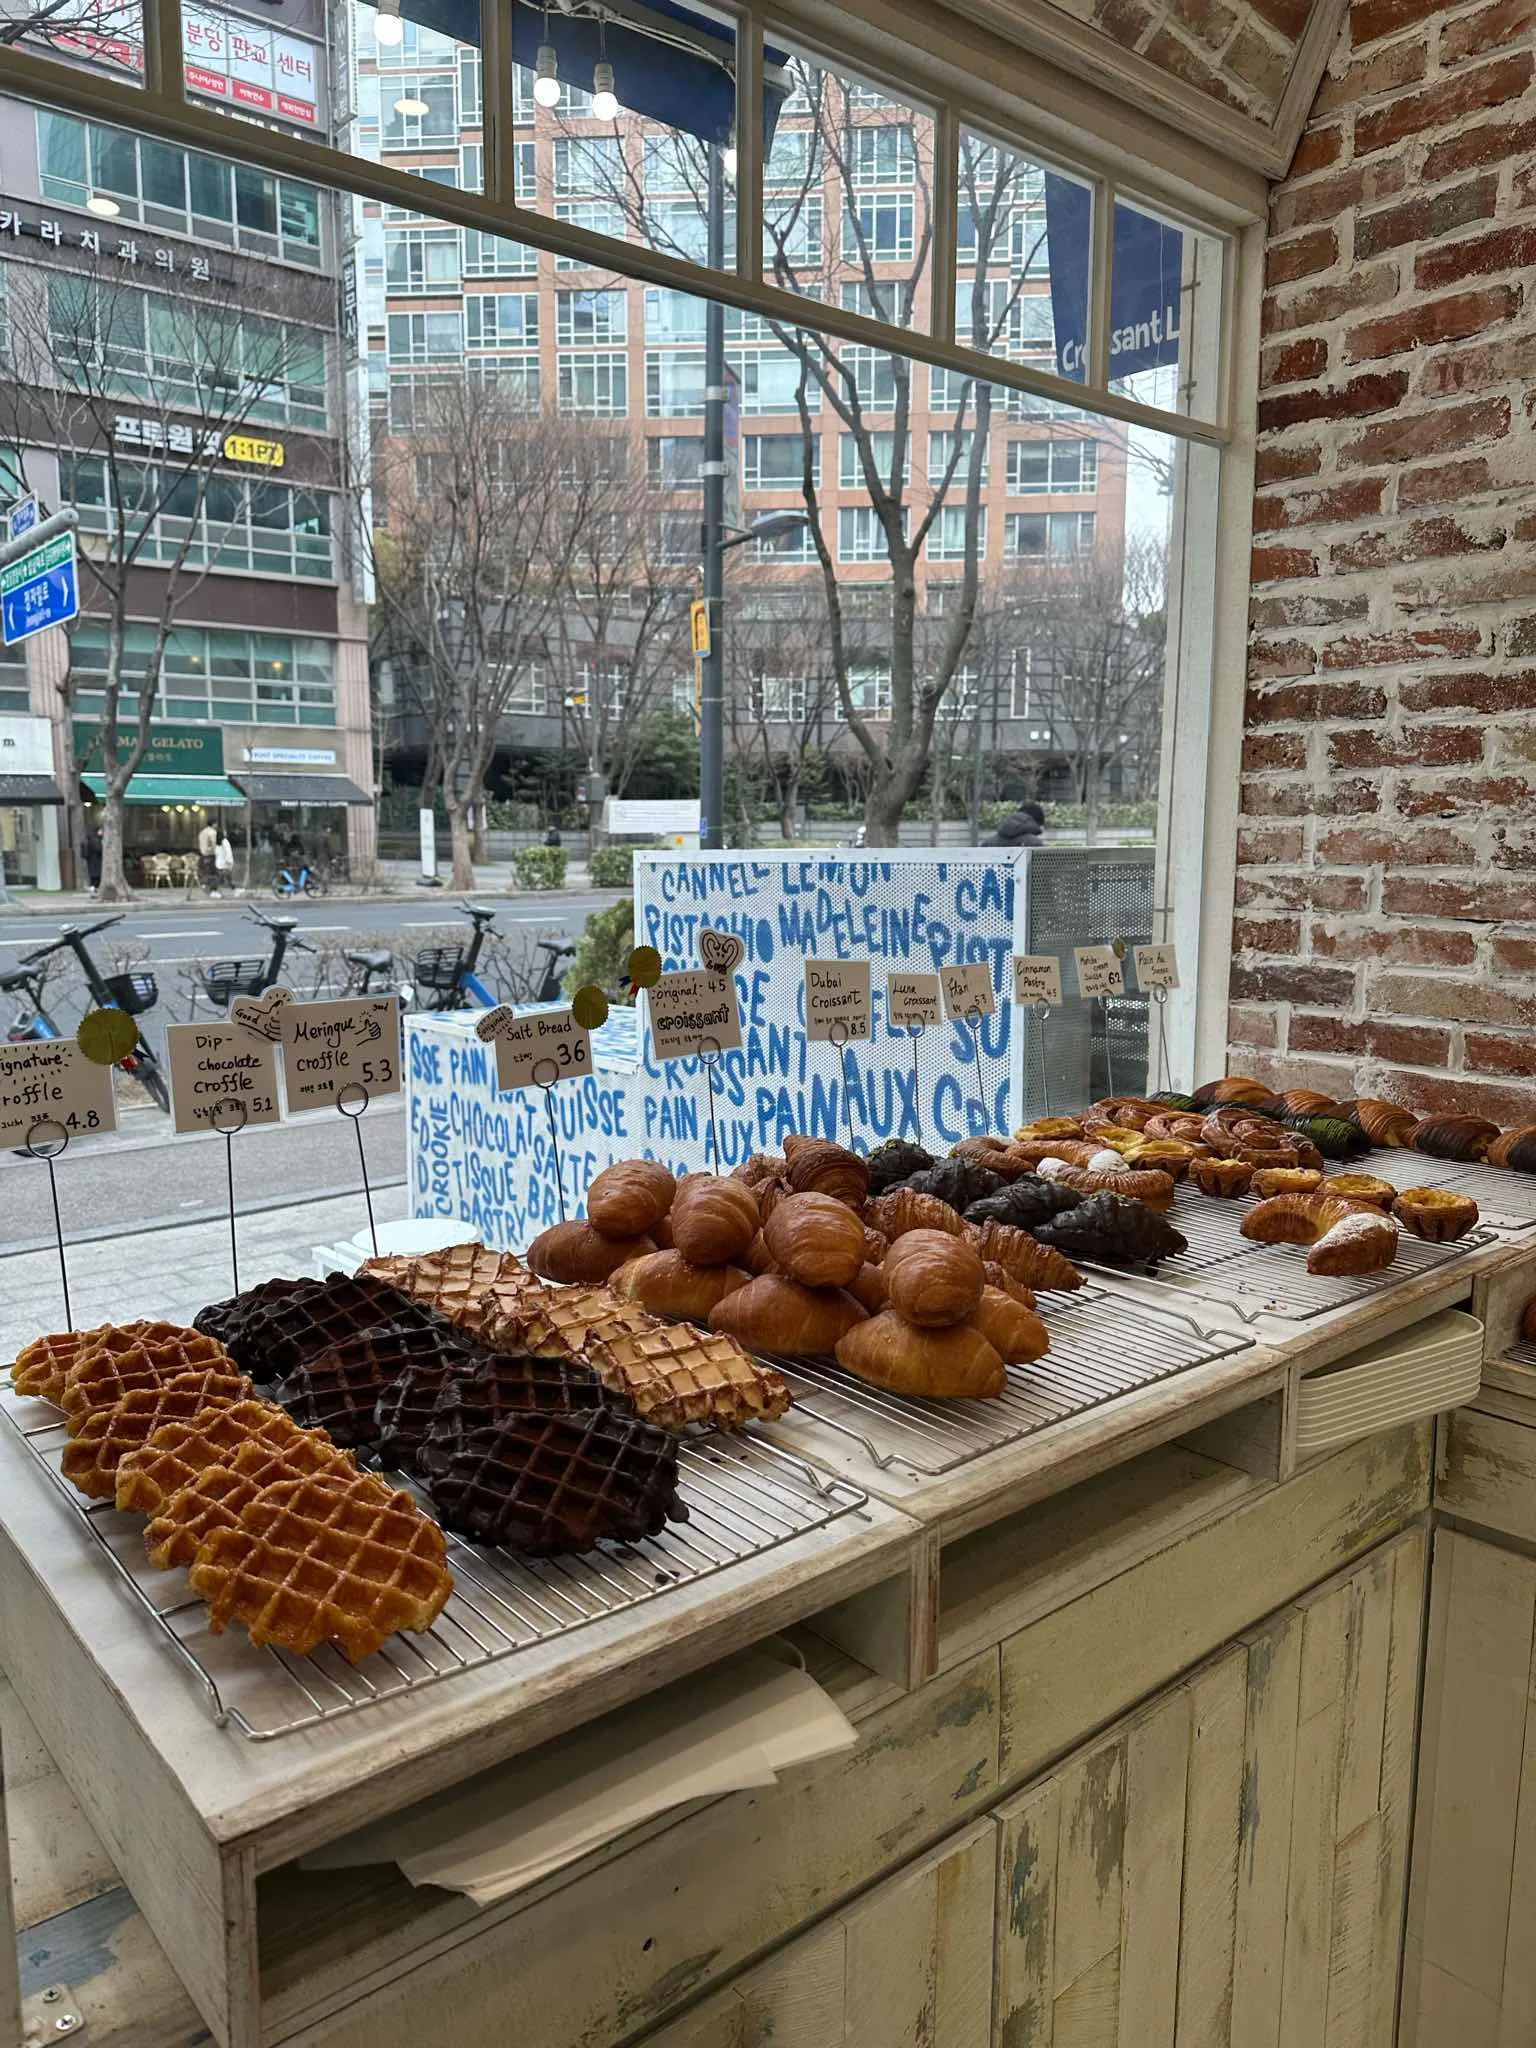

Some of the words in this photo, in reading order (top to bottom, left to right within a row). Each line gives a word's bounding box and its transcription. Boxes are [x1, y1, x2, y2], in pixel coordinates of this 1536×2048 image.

[186, 20, 223, 53] 분당
[231, 35, 269, 66] 판교
[276, 51, 313, 83] 센터
[151, 736, 204, 750] GELATO
[778, 893, 930, 958] MADELEINE
[810, 972, 842, 989] Dubai
[292, 1017, 356, 1048] Meringue
[506, 1023, 533, 1041] Salt
[537, 1015, 572, 1037] Bread
[850, 1021, 866, 1035] 8.5
[362, 1058, 393, 1083] 5.3
[252, 1096, 273, 1113] 5.1
[756, 1073, 839, 1148] PAIN
[842, 1048, 922, 1140] AUX
[65, 1110, 101, 1130] 4.8
[450, 1091, 537, 1158] CHOCOLAT
[544, 1076, 628, 1142] SUISSE
[644, 1095, 699, 1142] PAIN
[704, 1120, 754, 1167] AUX
[429, 1096, 453, 1215] CROOKIE
[452, 1151, 518, 1206] TISSUE
